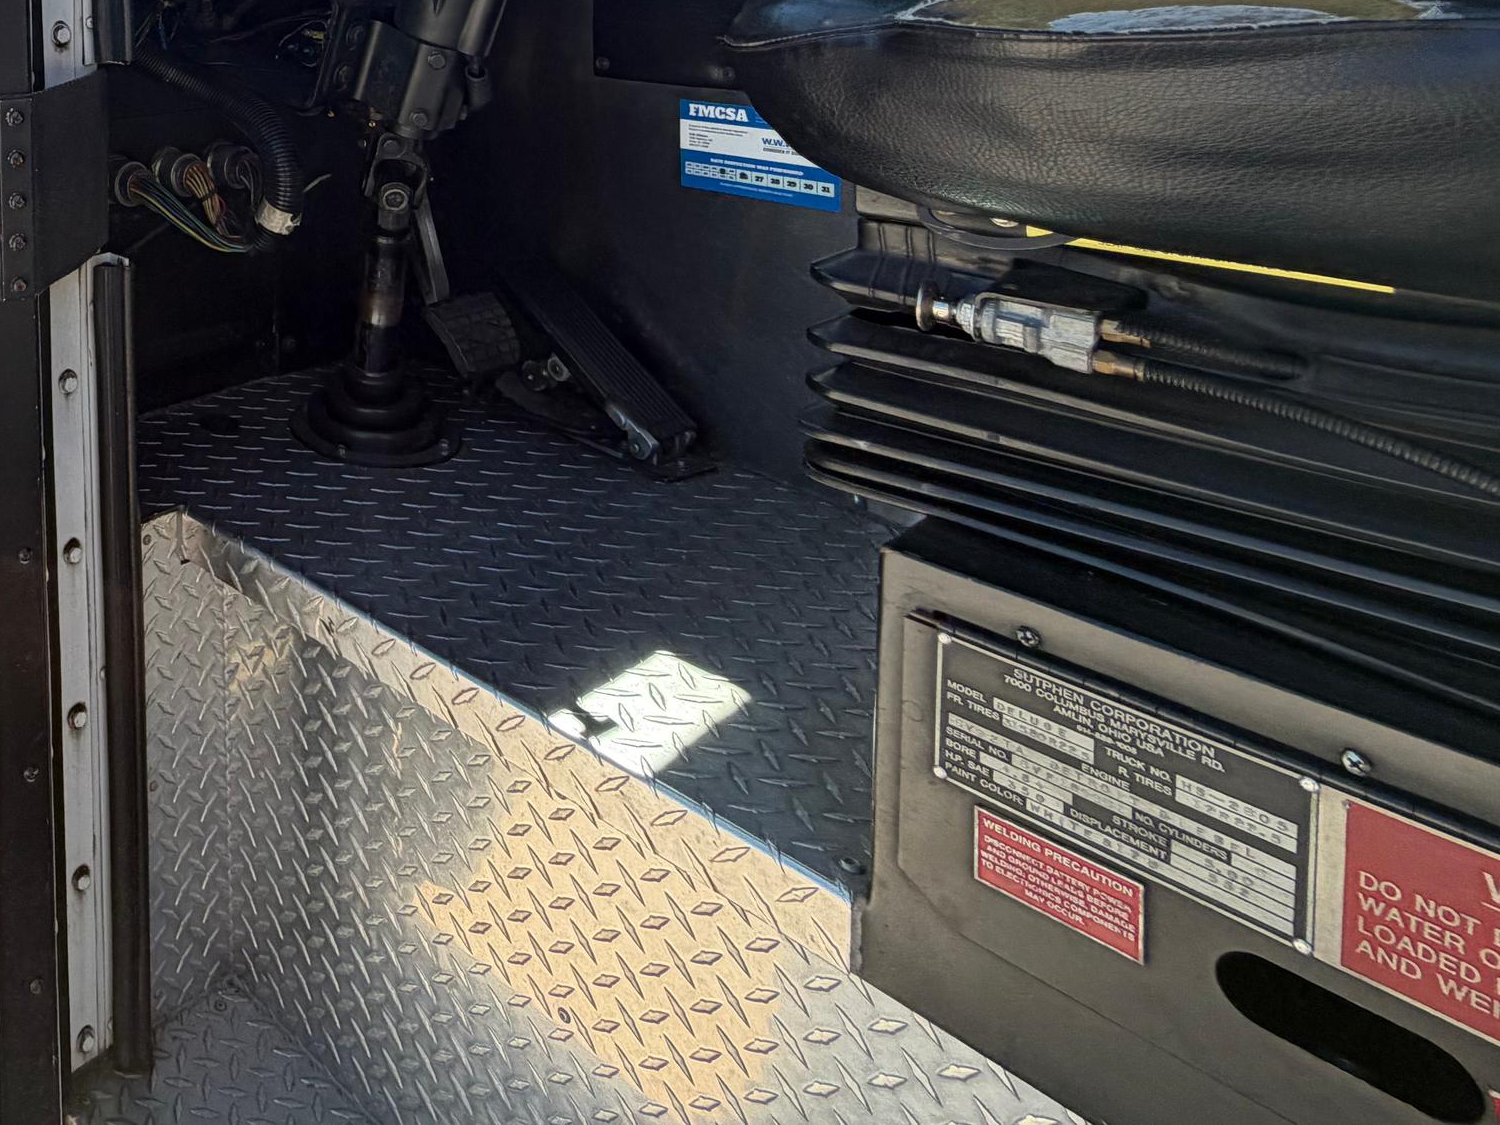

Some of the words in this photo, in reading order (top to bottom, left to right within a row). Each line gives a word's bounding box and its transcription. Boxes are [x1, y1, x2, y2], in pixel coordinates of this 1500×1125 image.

[688, 103, 749, 123] FMCSA
[754, 175, 765, 183] 27
[803, 182, 814, 190] 30
[821, 185, 831, 193] 31
[946, 678, 987, 704] MODEL
[946, 691, 964, 706] FR.
[966, 699, 1000, 722] TIRES
[1003, 673, 1031, 693] 7000
[1035, 687, 1105, 723] COLUMBUS
[1109, 717, 1196, 761] MARYSVILLE
[1201, 754, 1225, 773] RD.
[1013, 667, 1084, 705] SUTPHEN
[1089, 698, 1215, 759] CORPORATION
[945, 724, 985, 750] SERIAL
[987, 744, 1009, 761] NO.
[945, 736, 977, 759] BORE
[1097, 722, 1131, 744] OHIO
[1135, 738, 1164, 758] USA
[944, 760, 977, 783] PAINT
[966, 759, 990, 777] SAE
[1080, 762, 1131, 792] ENGINE
[1104, 745, 1146, 772] TRUCK
[1148, 764, 1172, 783] NO.
[1117, 765, 1130, 779] R.
[1133, 772, 1173, 798] TIRES
[1069, 807, 1167, 861] DISPLACEMENT
[1110, 813, 1168, 848] STROKE
[1134, 810, 1155, 829] NO.
[1157, 821, 1228, 862] CYLINDERS
[980, 857, 993, 870] TO
[982, 816, 1041, 854] WELDING
[1044, 846, 1133, 898] PRECAUTION
[983, 833, 1045, 871] DISCONNECT
[1045, 863, 1090, 893] BATTERY
[1092, 886, 1132, 914] POWER
[985, 843, 1006, 860] AND
[1007, 854, 1049, 881] GROUND
[1086, 893, 1130, 922] BEFORE
[1024, 887, 1045, 906] MAY
[1090, 903, 1135, 933] DAMAGE
[1358, 870, 1402, 902] DO
[1414, 893, 1482, 936] NOT
[1357, 891, 1466, 955] WATER
[1355, 939, 1422, 980] AND
[1357, 914, 1482, 984] LOADED
